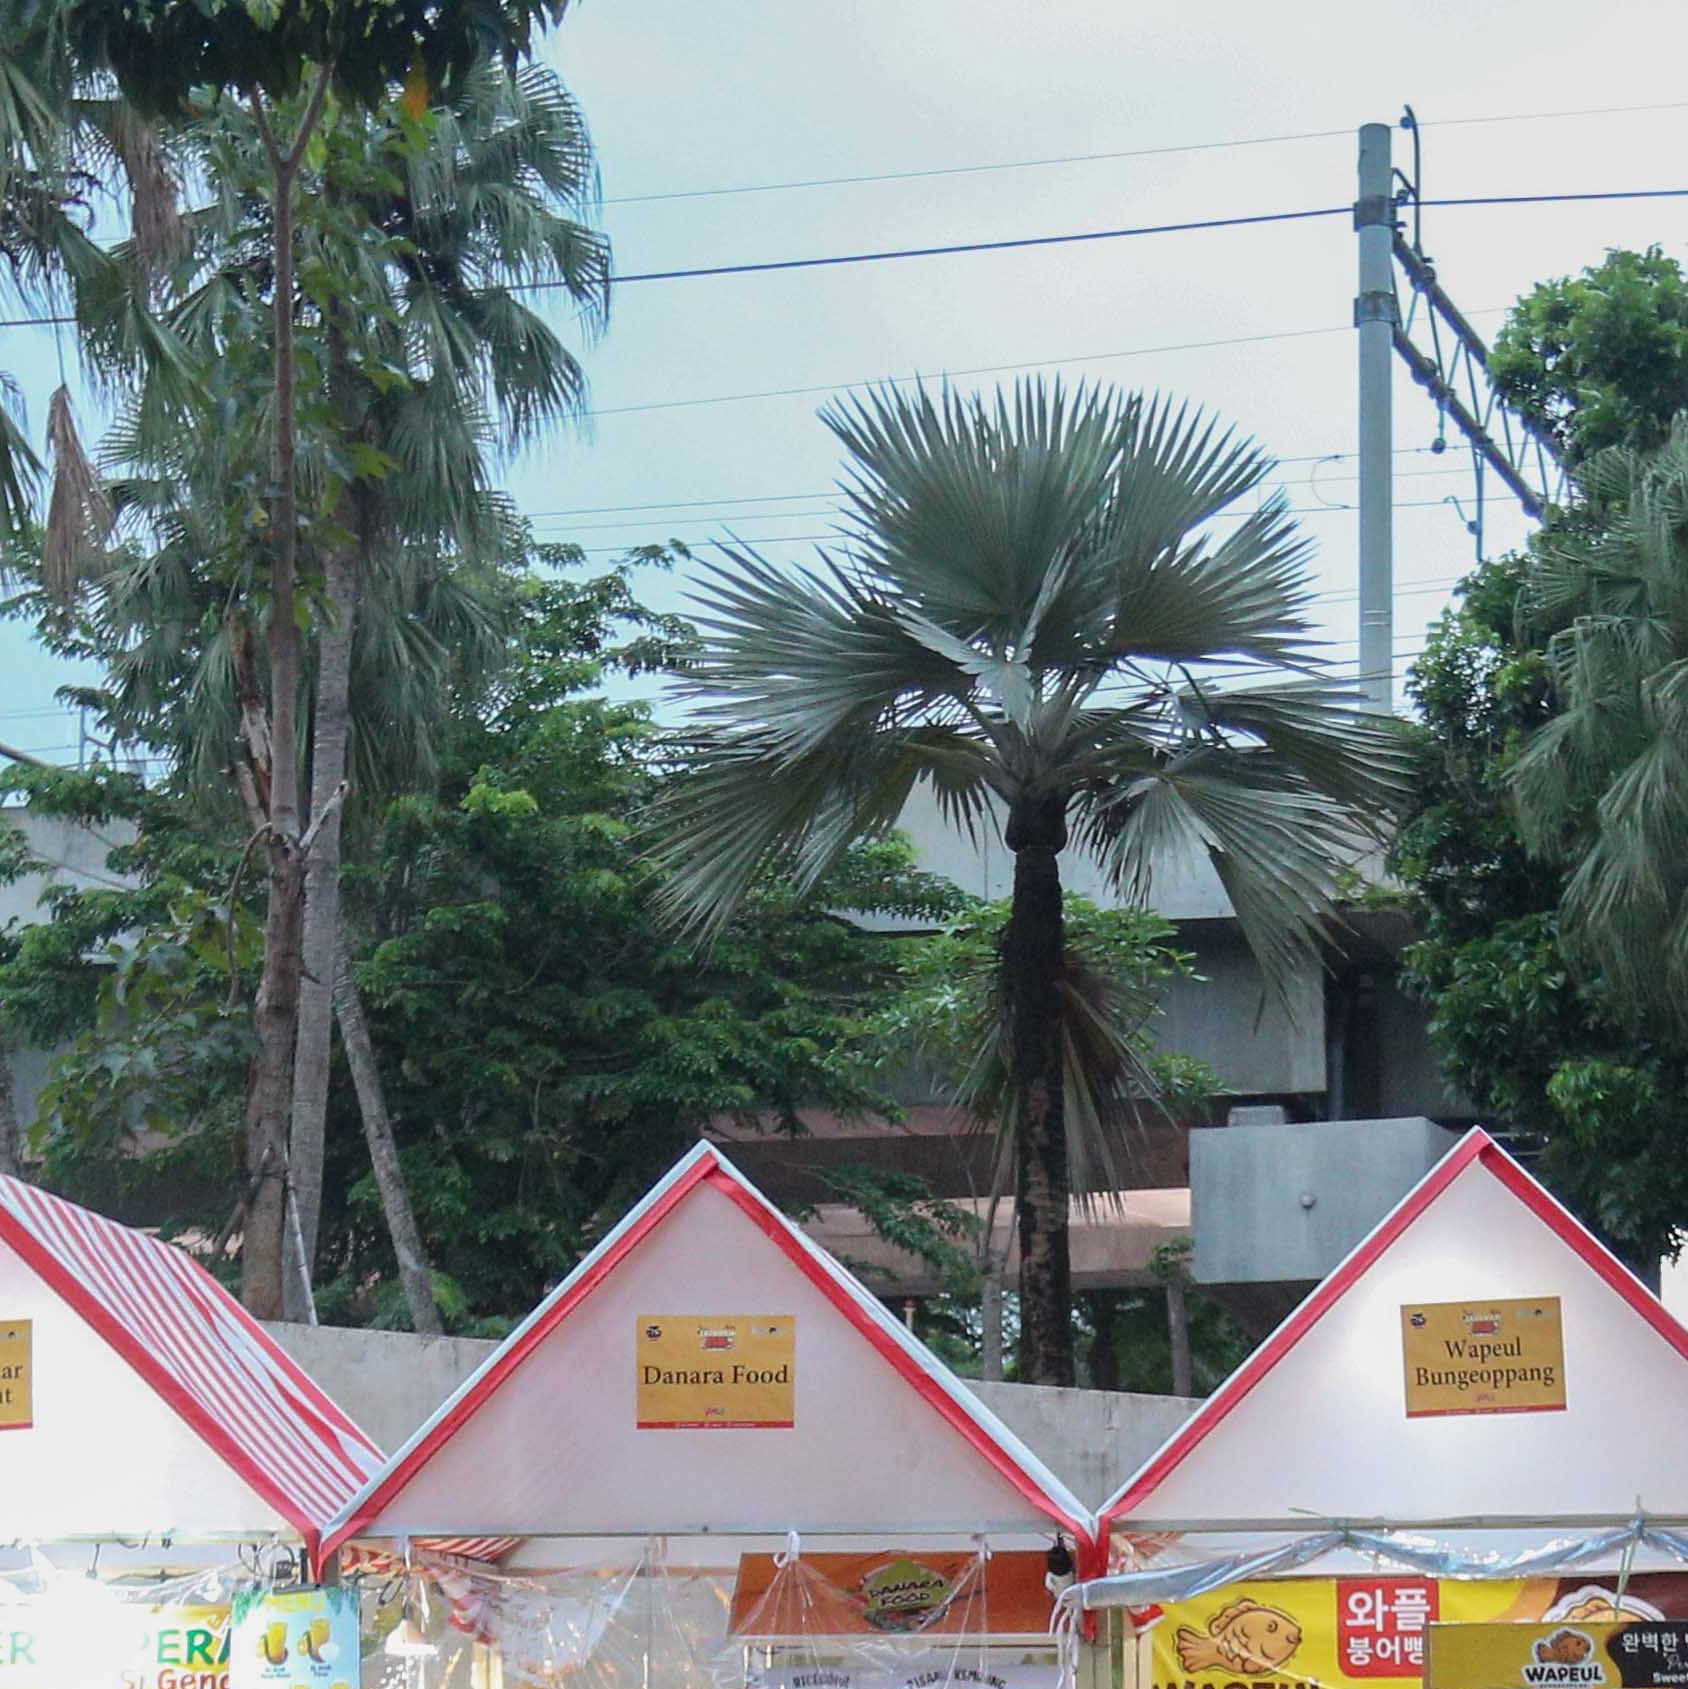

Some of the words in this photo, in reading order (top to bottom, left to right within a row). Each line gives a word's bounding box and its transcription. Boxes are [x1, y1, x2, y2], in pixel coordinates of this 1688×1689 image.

[1445, 1337, 1522, 1364] Wapeul
[643, 1366, 724, 1385] Danara
[731, 1364, 788, 1384] Food
[1416, 1366, 1555, 1391] Bungeoppang
[881, 1591, 931, 1607] FOOD
[1344, 1588, 1432, 1632] 와플
[1346, 1637, 1424, 1666] 붕어빵
[1622, 1632, 1679, 1653] 완벽한
[1525, 1665, 1603, 1682] WAPEUL
